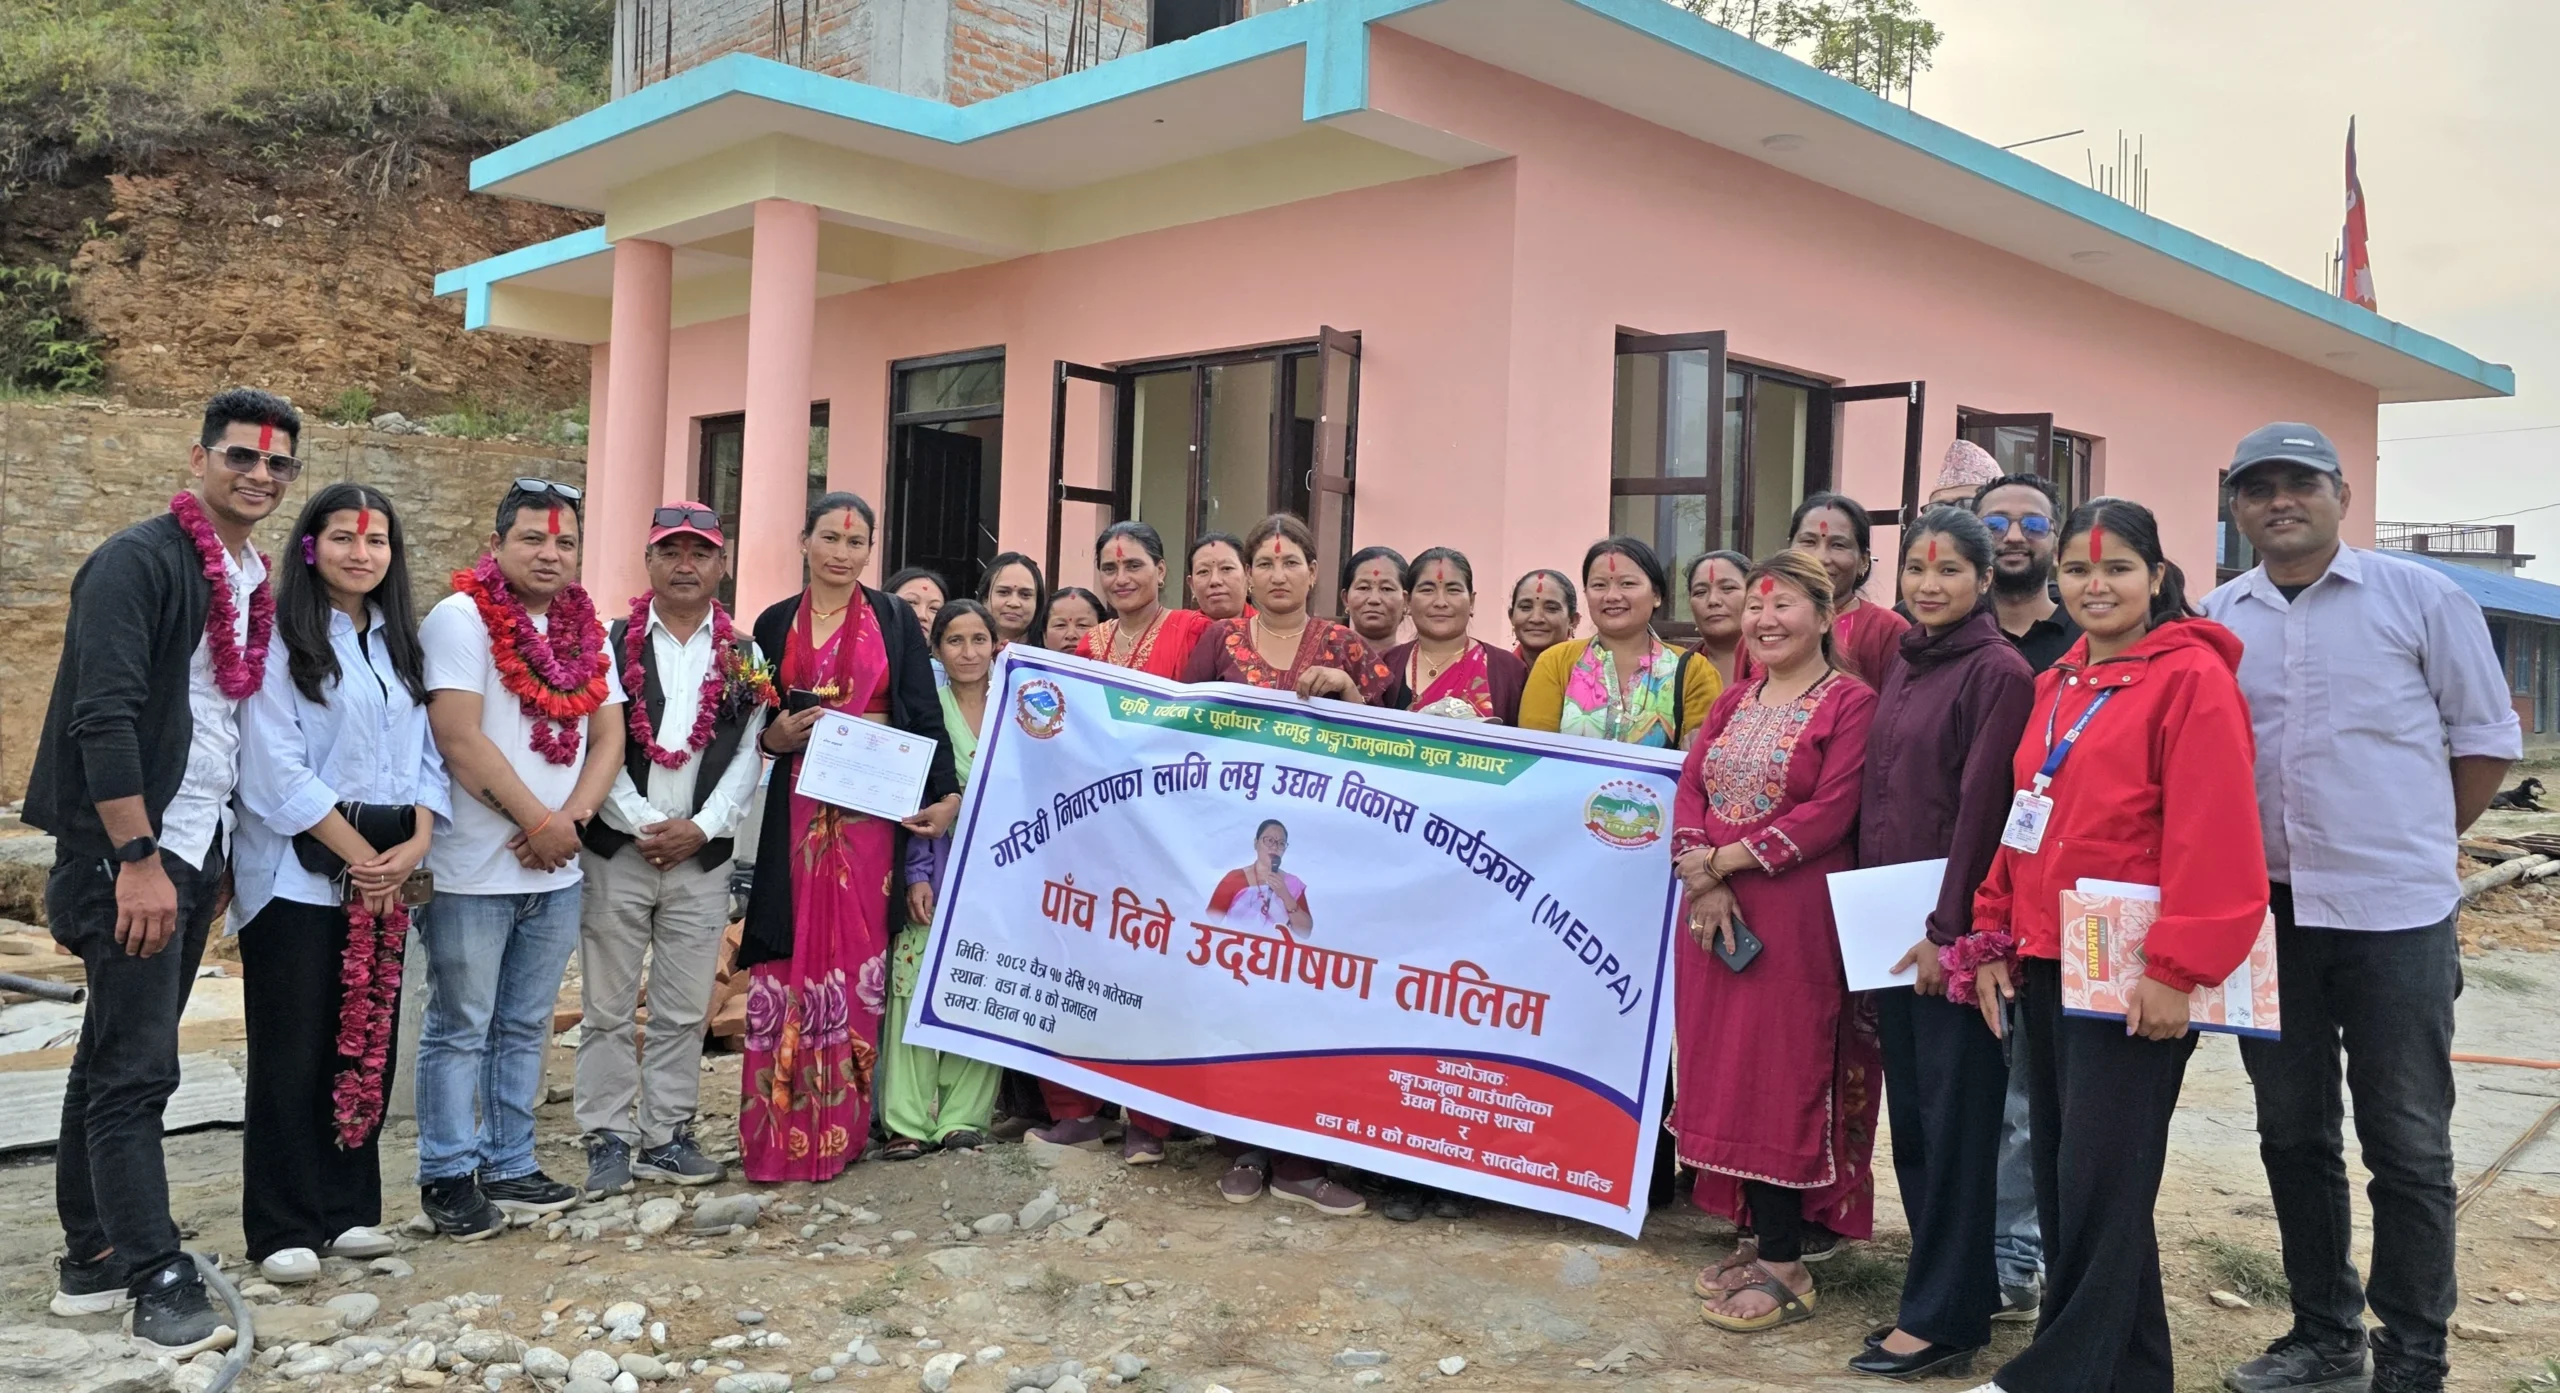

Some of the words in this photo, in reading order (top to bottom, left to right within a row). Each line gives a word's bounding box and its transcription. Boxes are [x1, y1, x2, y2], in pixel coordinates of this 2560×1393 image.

[1153, 703, 1191, 720] पर्यटन
[1194, 707, 1205, 724] र
[1315, 728, 1417, 759] गङ्गाजमुनाको
[1419, 746, 1452, 766] मुल
[990, 807, 1050, 868] गरिबी
[1053, 768, 1143, 832] निवारणका
[1152, 751, 1212, 796] लागि
[1219, 761, 1265, 801] लघु
[1336, 770, 1420, 833] विकास
[1423, 812, 1536, 902] कार्यक्रम
[1531, 893, 1643, 1015] (MEDPA)
[1041, 872, 1098, 933] पाँच
[1109, 887, 1176, 955] दिने
[1395, 960, 1551, 1036] तालिम
[2087, 917, 2099, 978] SAYAPATRI
[994, 977, 1018, 997] वडा
[1034, 988, 1042, 1003] ४
[1044, 989, 1060, 1009] को
[996, 952, 1027, 973] २०८२
[1029, 956, 1048, 979] चैत्र
[1049, 966, 1062, 983] १७
[1064, 968, 1086, 991] देखि
[1087, 979, 1100, 996] २१
[1102, 983, 1144, 1010] गतेसम्म
[983, 997, 1021, 1023] विहान
[1022, 1011, 1037, 1027] १०
[1039, 1014, 1056, 1034] बजे
[1440, 1098, 1490, 1124] विकास
[1493, 1113, 1536, 1134] शाखा
[1467, 1088, 1554, 1118] गाउँपालिका
[1315, 1112, 1344, 1131] वडा
[1366, 1126, 1376, 1139] ४
[1381, 1126, 1404, 1146] को
[1458, 1125, 1470, 1141] र
